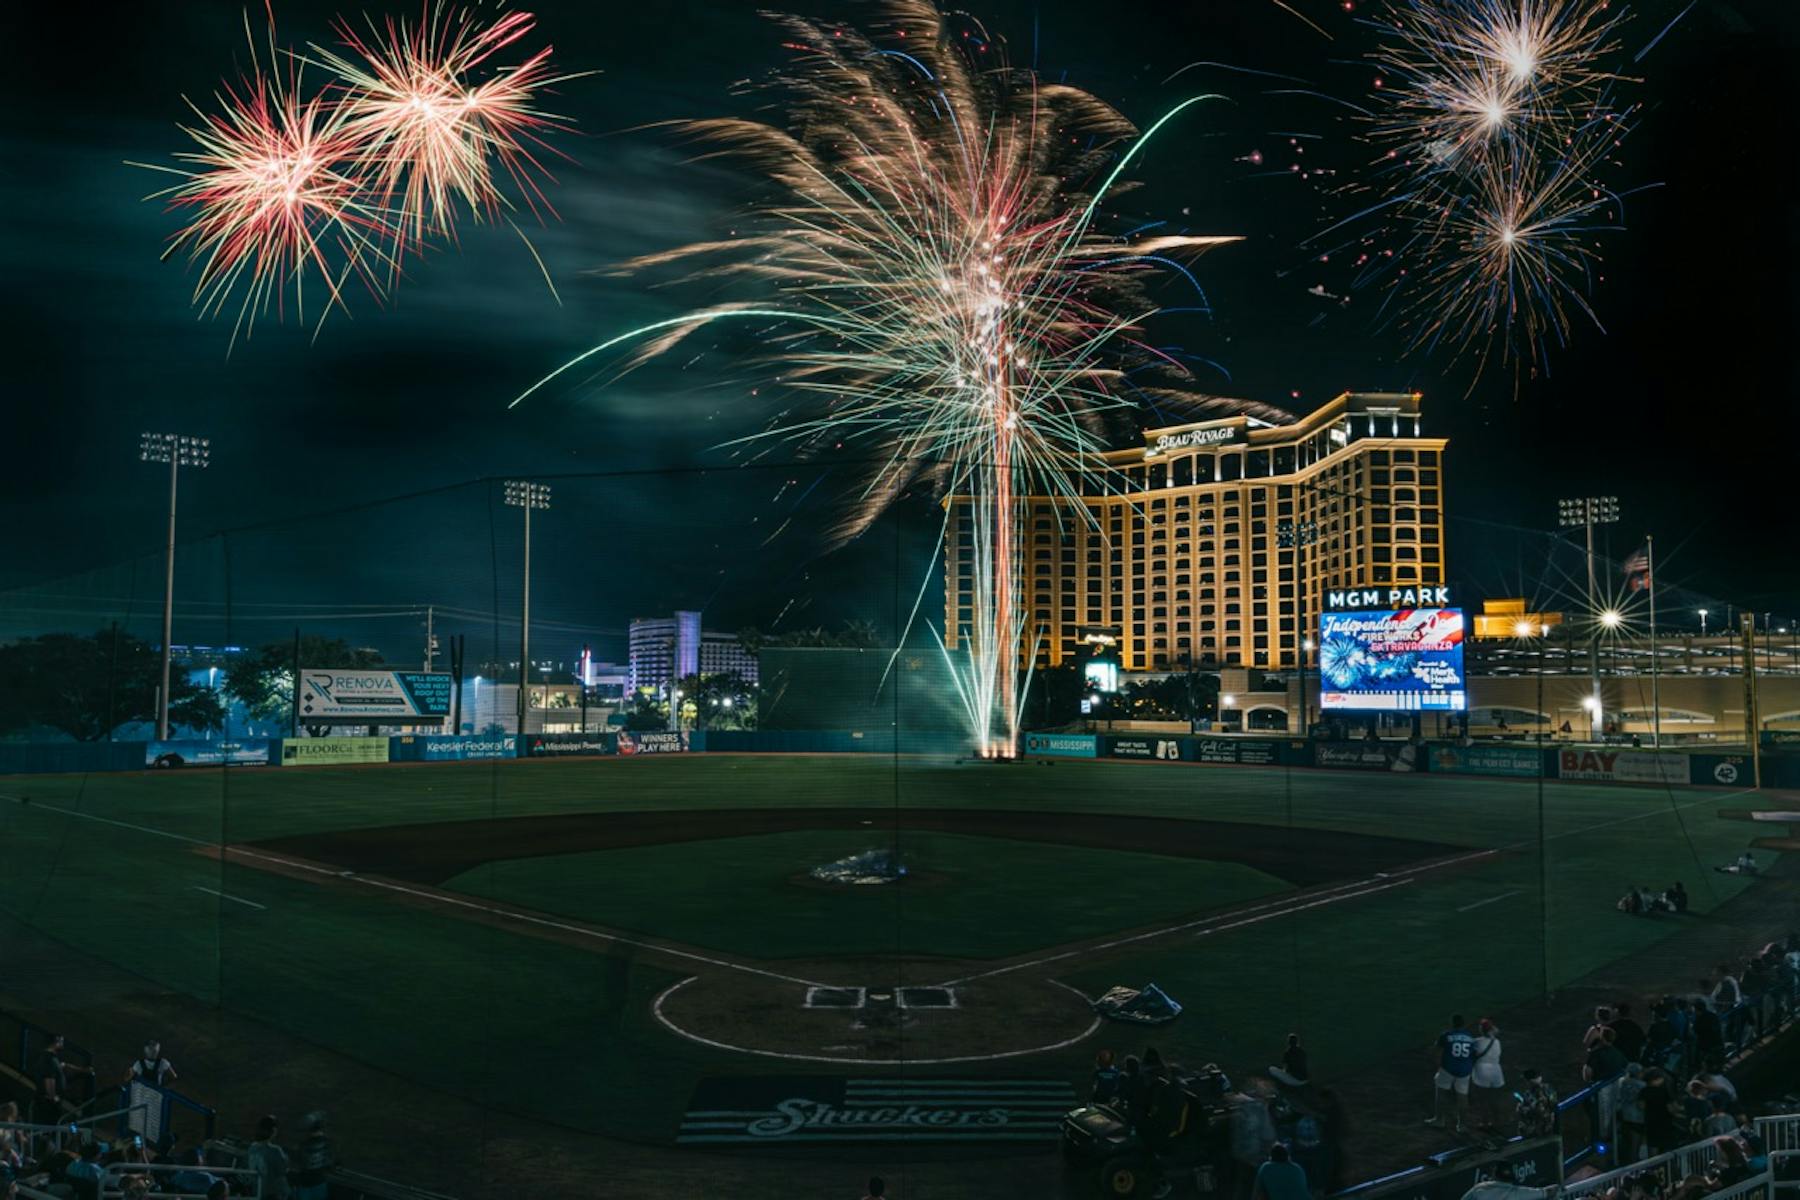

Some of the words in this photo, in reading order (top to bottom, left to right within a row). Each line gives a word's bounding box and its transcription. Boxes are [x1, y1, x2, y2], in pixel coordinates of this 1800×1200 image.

[1330, 591, 1379, 607] MGM
[1389, 587, 1450, 604] PARK
[1371, 641, 1453, 652] EXTRAVAGANZA
[336, 677, 393, 689] RENOVA
[641, 733, 678, 743] WINNERS
[637, 742, 658, 752] PLAY
[658, 742, 681, 752] HERE
[1049, 740, 1094, 751] MISSISSIPPI
[1561, 751, 1619, 773] BAY
[1716, 767, 1734, 780] 42
[1451, 1042, 1472, 1058] 85
[747, 1097, 1009, 1136] Shuckers
